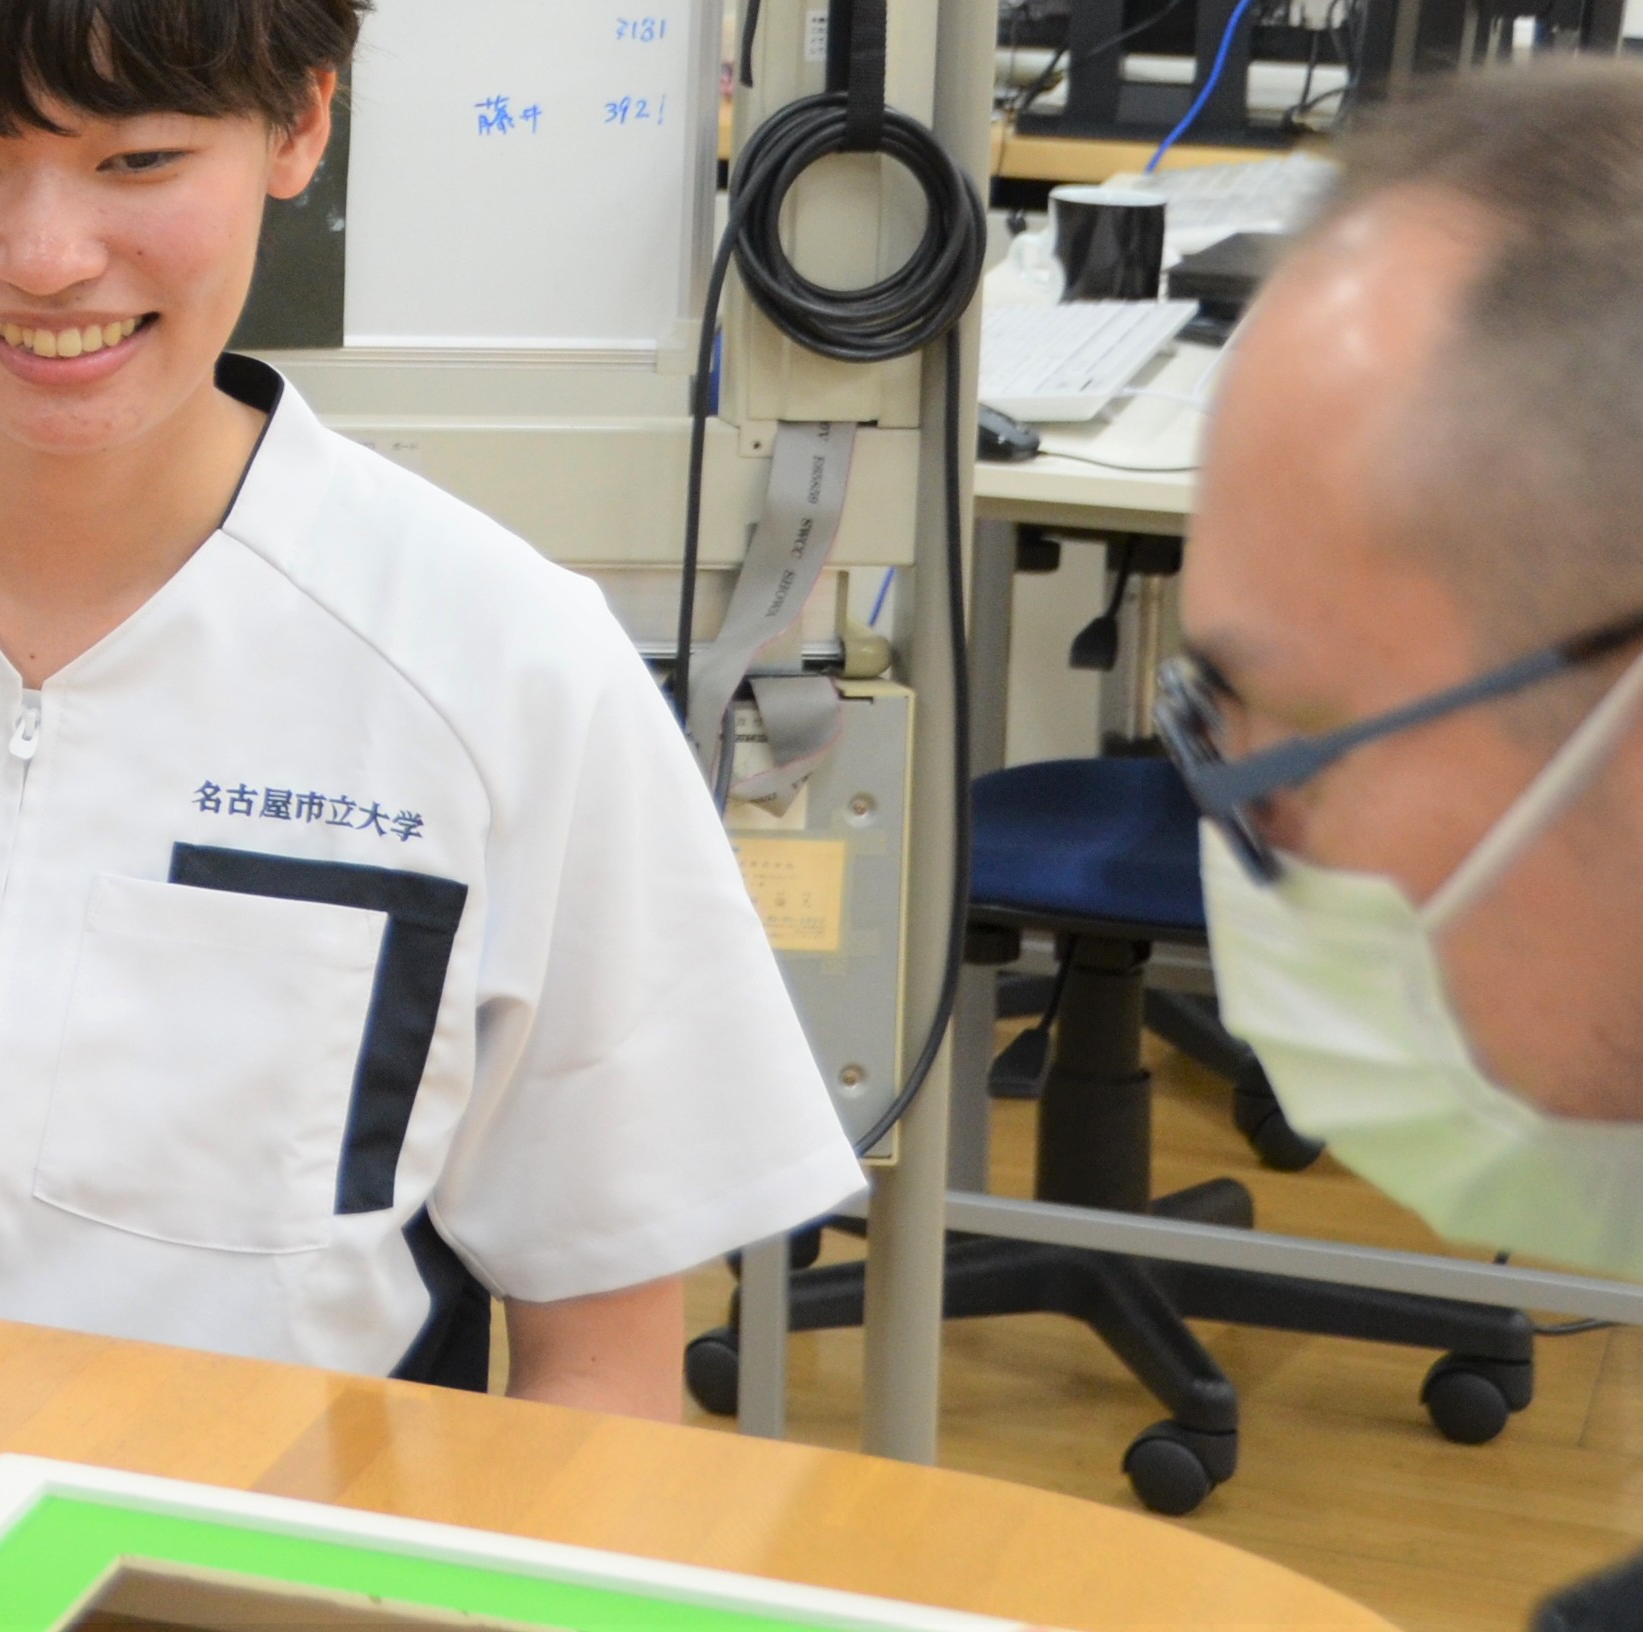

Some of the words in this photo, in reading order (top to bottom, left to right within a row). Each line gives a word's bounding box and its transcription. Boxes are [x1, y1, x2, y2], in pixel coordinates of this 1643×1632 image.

[474, 95, 543, 135] 藤井
[603, 93, 667, 126] 3921
[791, 516, 813, 560] SWCC
[764, 569, 796, 619] SHOWA
[191, 779, 424, 842] 名古屋市立大学
